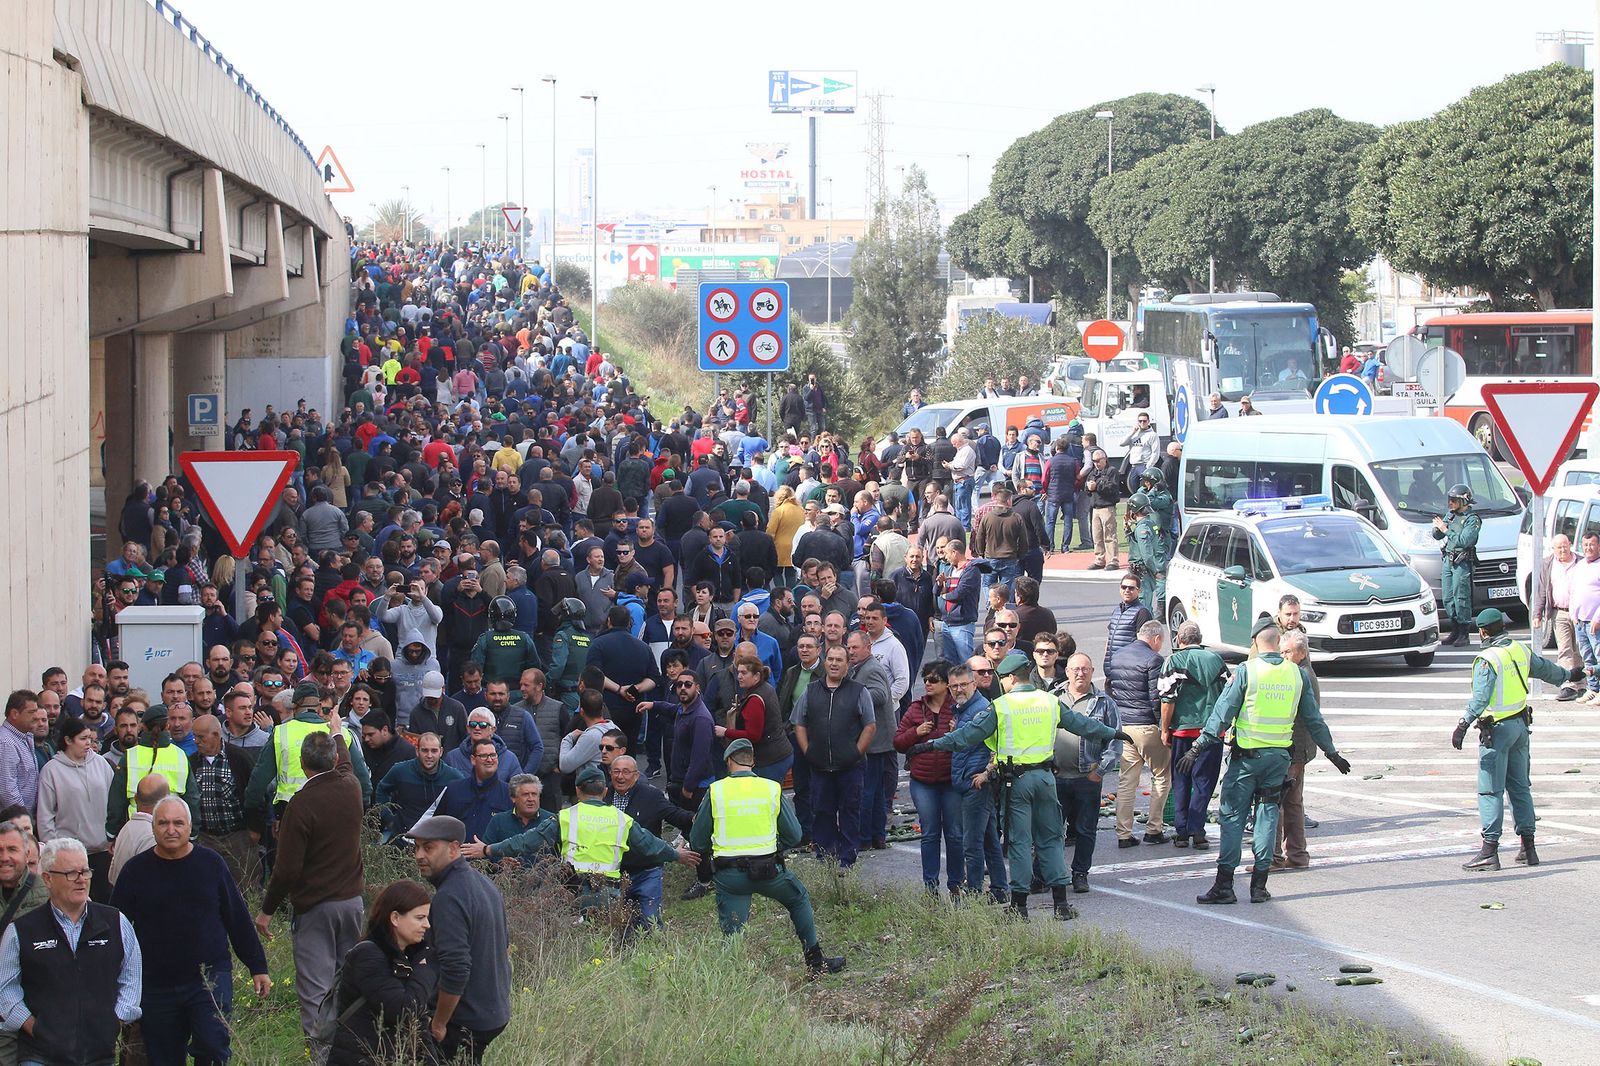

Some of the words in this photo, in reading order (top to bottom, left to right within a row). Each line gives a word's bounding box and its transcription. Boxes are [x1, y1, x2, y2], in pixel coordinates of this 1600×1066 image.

[740, 169, 793, 179] HOSTAL
[545, 253, 594, 263] Carrefou
[194, 398, 212, 422] P
[155, 649, 173, 657] DGT
[1259, 683, 1294, 691] GUARDIA
[1265, 691, 1286, 701] CIVIL
[1013, 705, 1049, 716] GUARDIA
[1022, 717, 1043, 726] CIVIL
[728, 798, 768, 807] GUARDIA
[580, 815, 617, 825] GUARDIA
